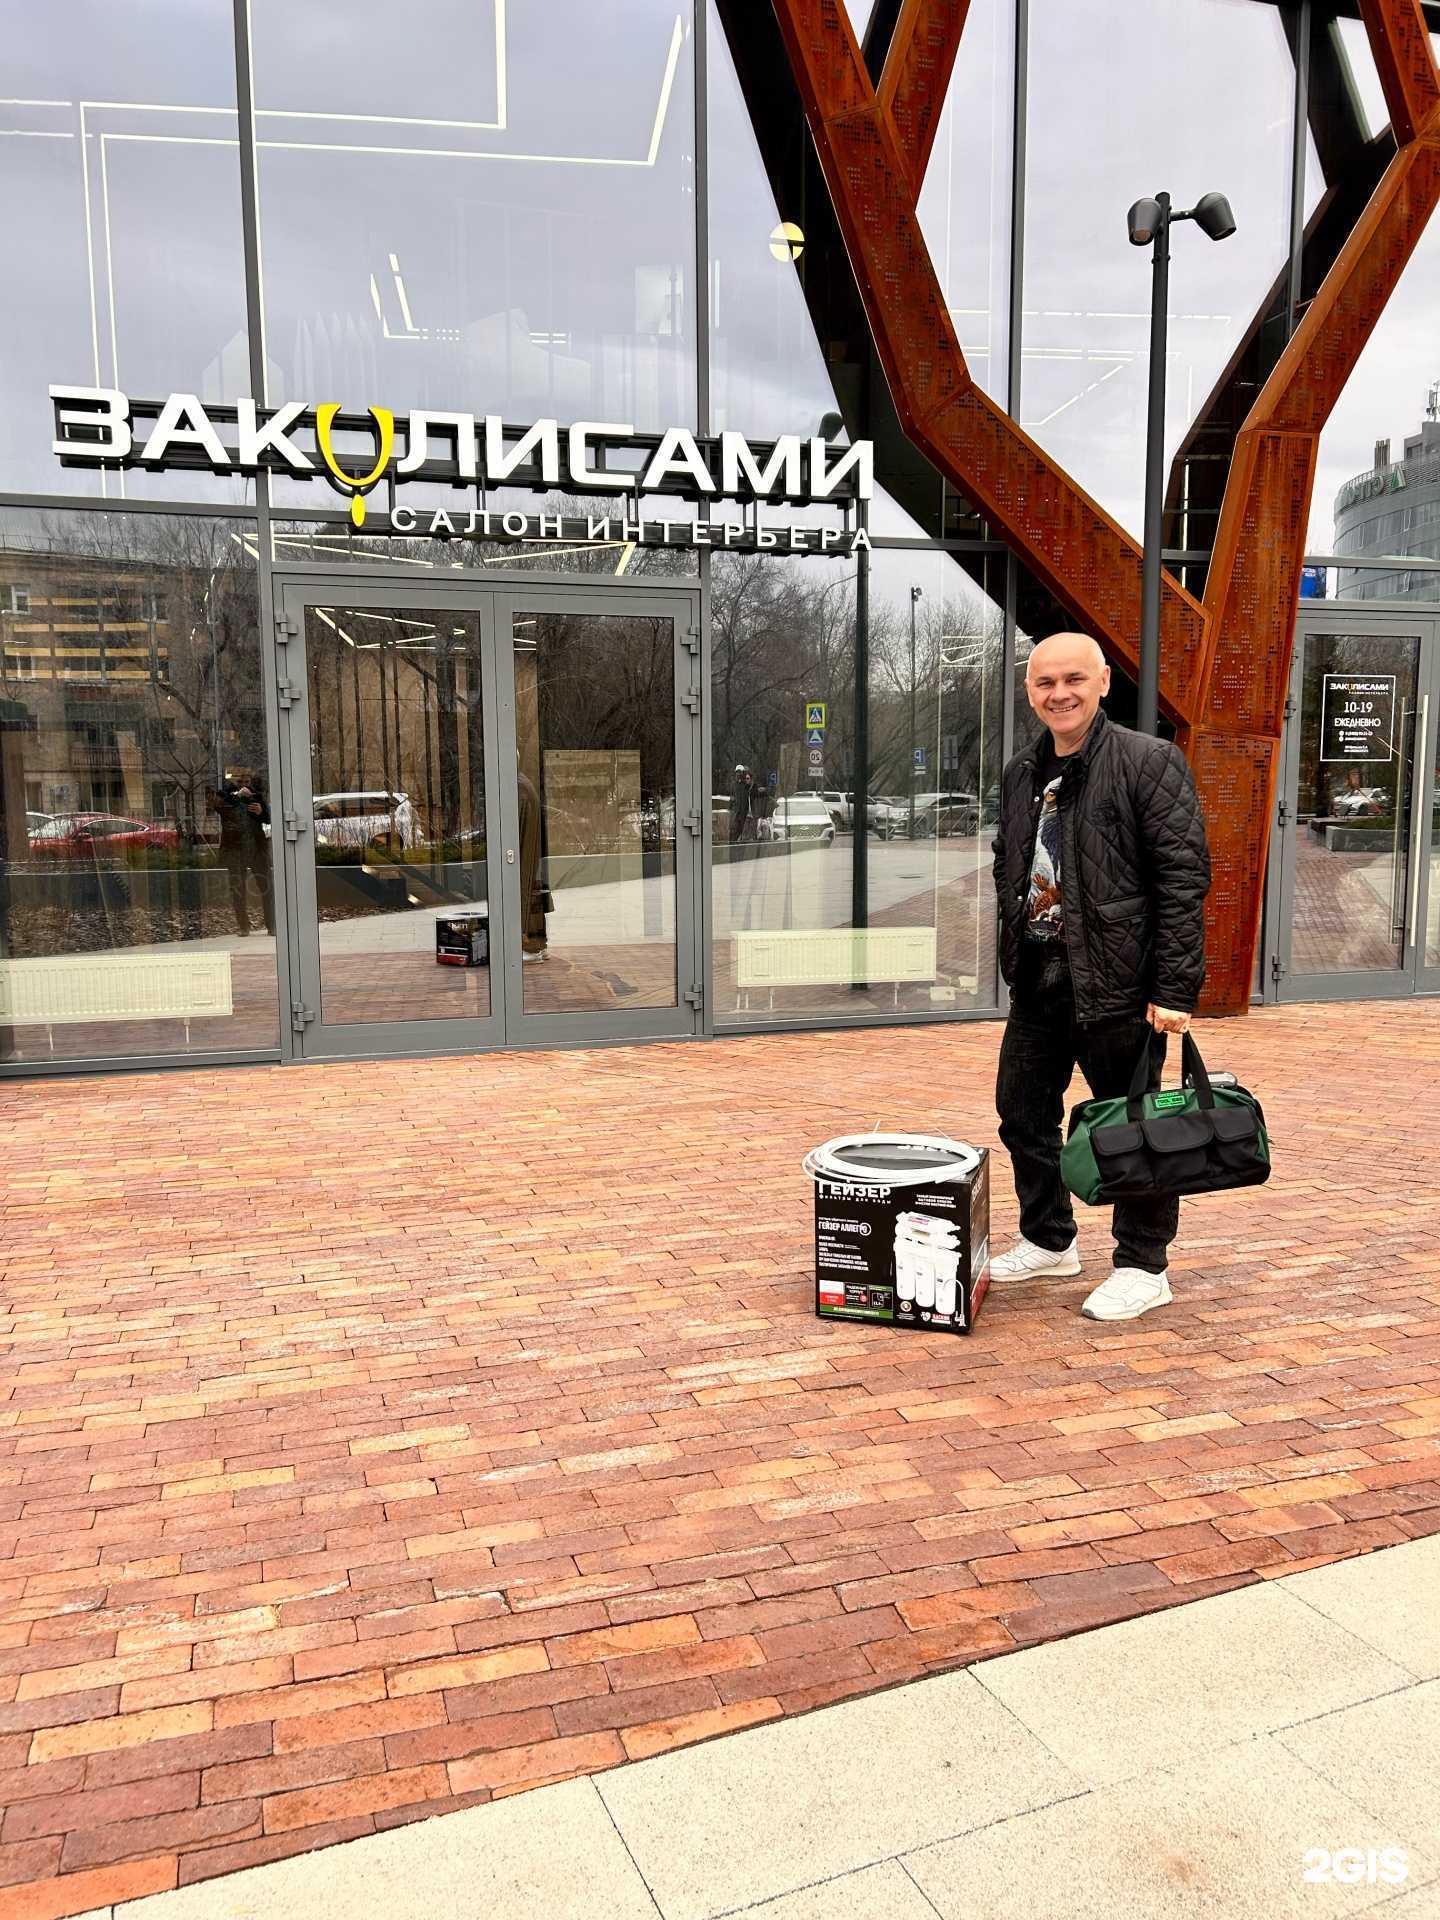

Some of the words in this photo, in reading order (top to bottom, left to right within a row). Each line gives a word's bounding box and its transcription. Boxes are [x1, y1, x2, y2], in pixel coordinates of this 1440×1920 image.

[391, 505, 563, 538] САЛОН
[587, 515, 874, 551] ИНТЕРЬЕРА
[1344, 701, 1373, 713] 10-19
[1334, 718, 1381, 728] ЕЖЕДНЕВНО
